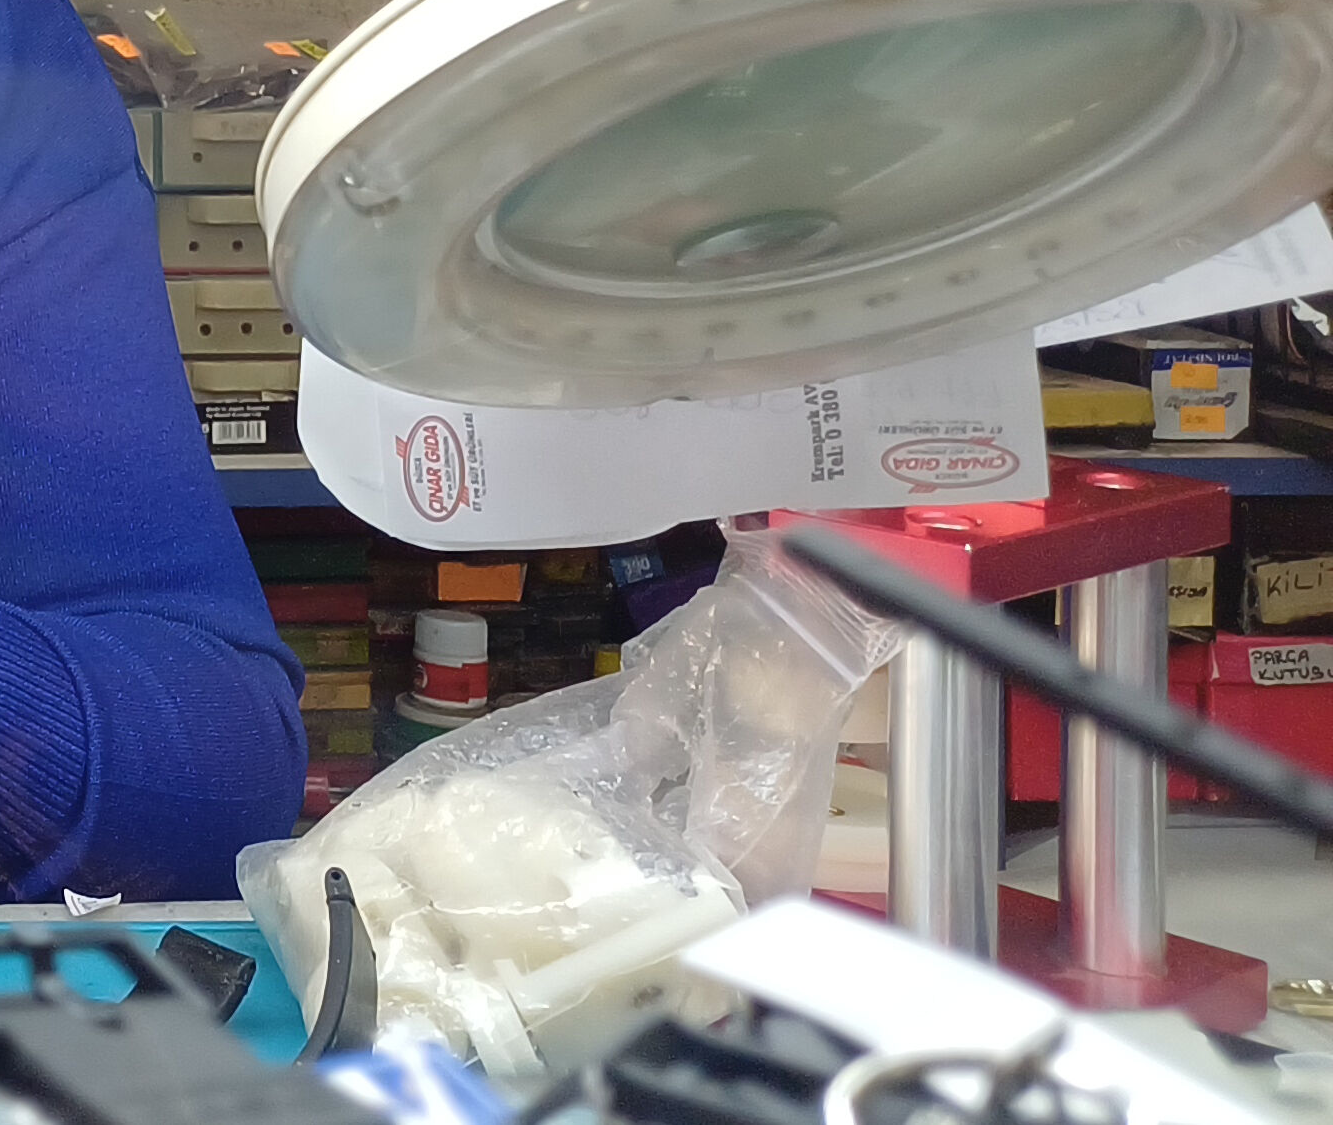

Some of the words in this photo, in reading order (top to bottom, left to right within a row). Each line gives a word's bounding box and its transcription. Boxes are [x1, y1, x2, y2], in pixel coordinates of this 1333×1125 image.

[821, 390, 840, 423] 380
[422, 425, 441, 463] GIDA
[824, 429, 842, 440] 0
[826, 445, 844, 480] Tel:
[893, 457, 941, 471] GIDA
[946, 453, 1007, 471] ÇINAR
[426, 467, 448, 514] ÇINAR
